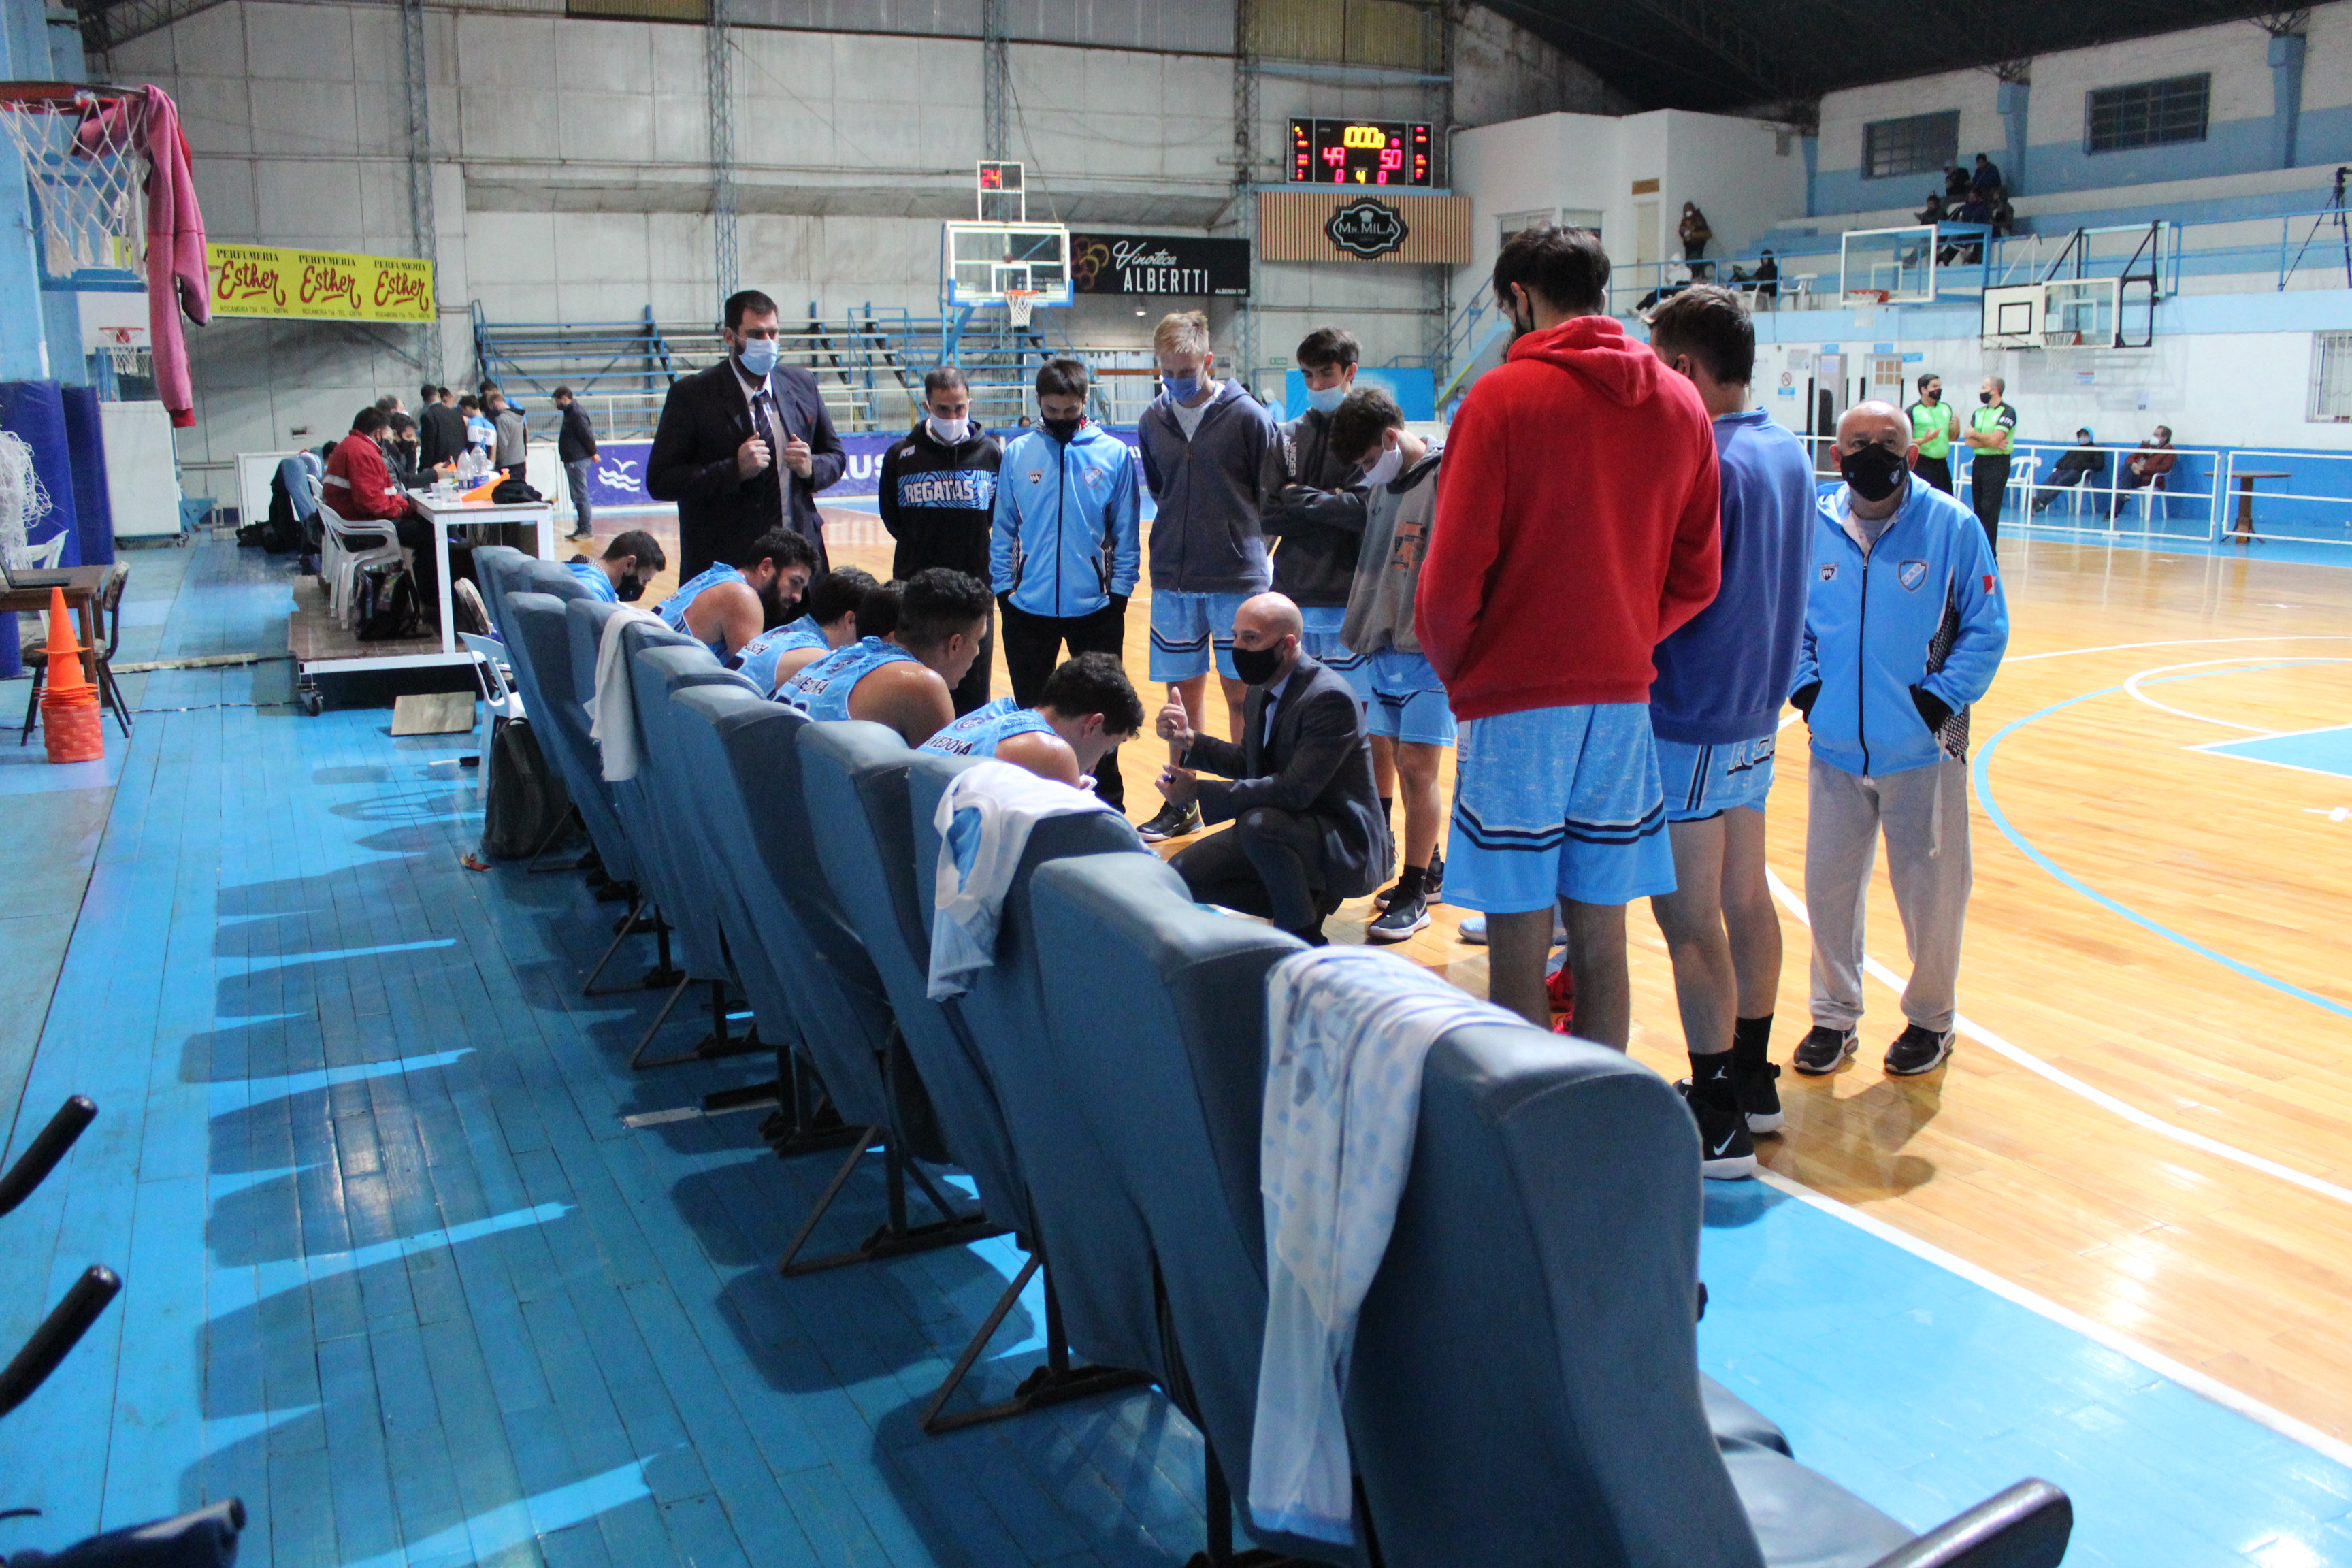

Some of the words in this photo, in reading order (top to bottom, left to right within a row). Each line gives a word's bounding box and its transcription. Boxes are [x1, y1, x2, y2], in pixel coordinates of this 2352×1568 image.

[1322, 146, 1346, 167] 49
[1379, 148, 1403, 170] 50
[981, 168, 1000, 187] 24
[1334, 169, 1345, 183] 0
[1377, 170, 1388, 185] 0
[1361, 223, 1396, 234] MILA
[217, 249, 279, 262] PERFUMERIA
[299, 255, 356, 267] PERFUMERIA
[374, 260, 426, 271] PERFUMERIA
[1112, 240, 1177, 270] Vinoteca
[217, 260, 286, 306] Esther
[299, 265, 361, 310] Esther
[1123, 267, 1209, 293] ALBERTTI
[374, 270, 429, 312] Esther
[904, 479, 974, 504] REGATAS
